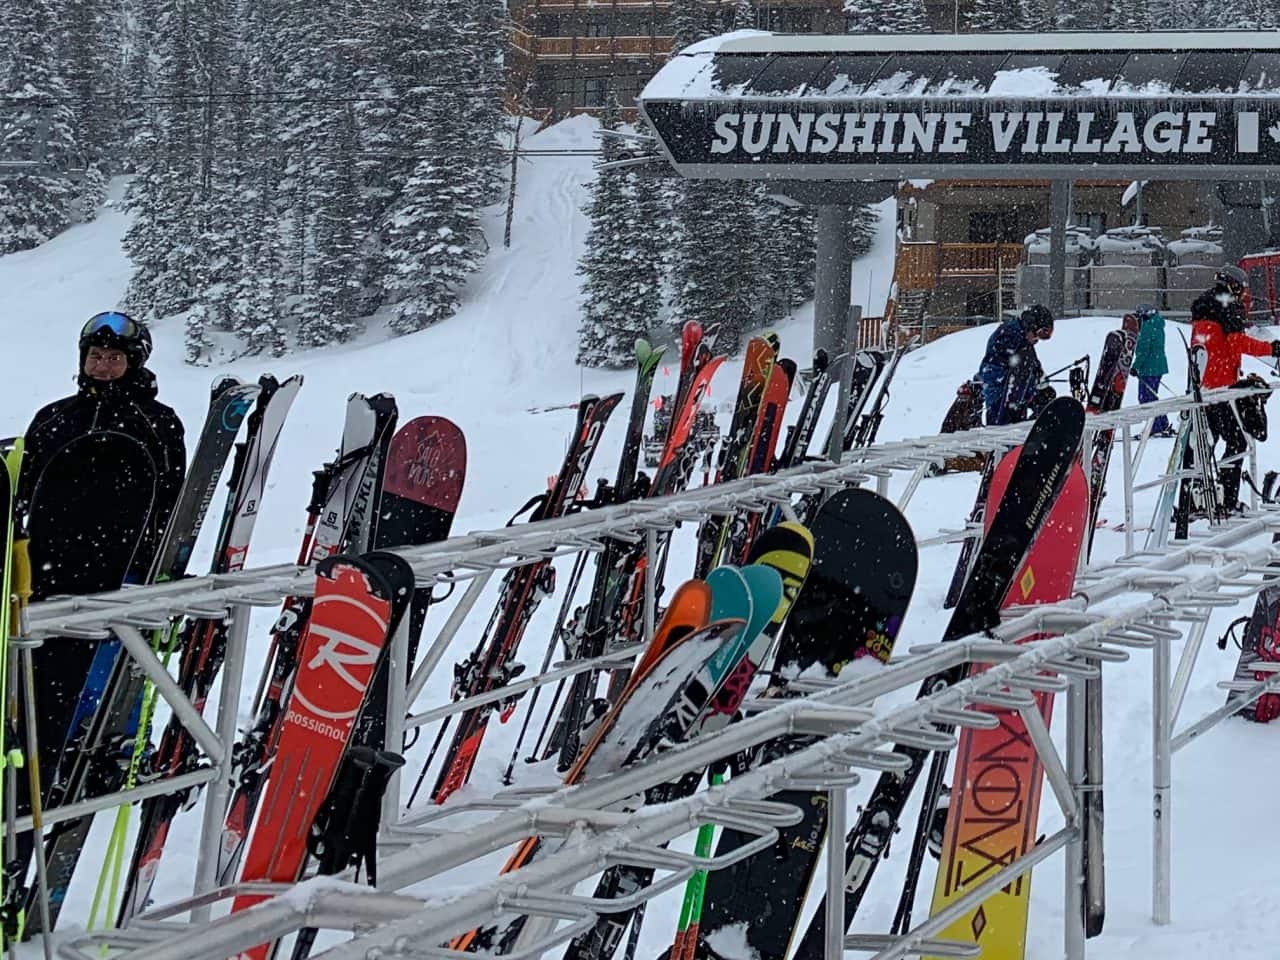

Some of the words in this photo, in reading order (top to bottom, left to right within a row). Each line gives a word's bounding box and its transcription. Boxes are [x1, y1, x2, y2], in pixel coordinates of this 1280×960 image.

[711, 112, 971, 153] SUNSHINE
[989, 112, 1216, 153] VILLAGE
[285, 711, 347, 743] ROSSIGNOL
